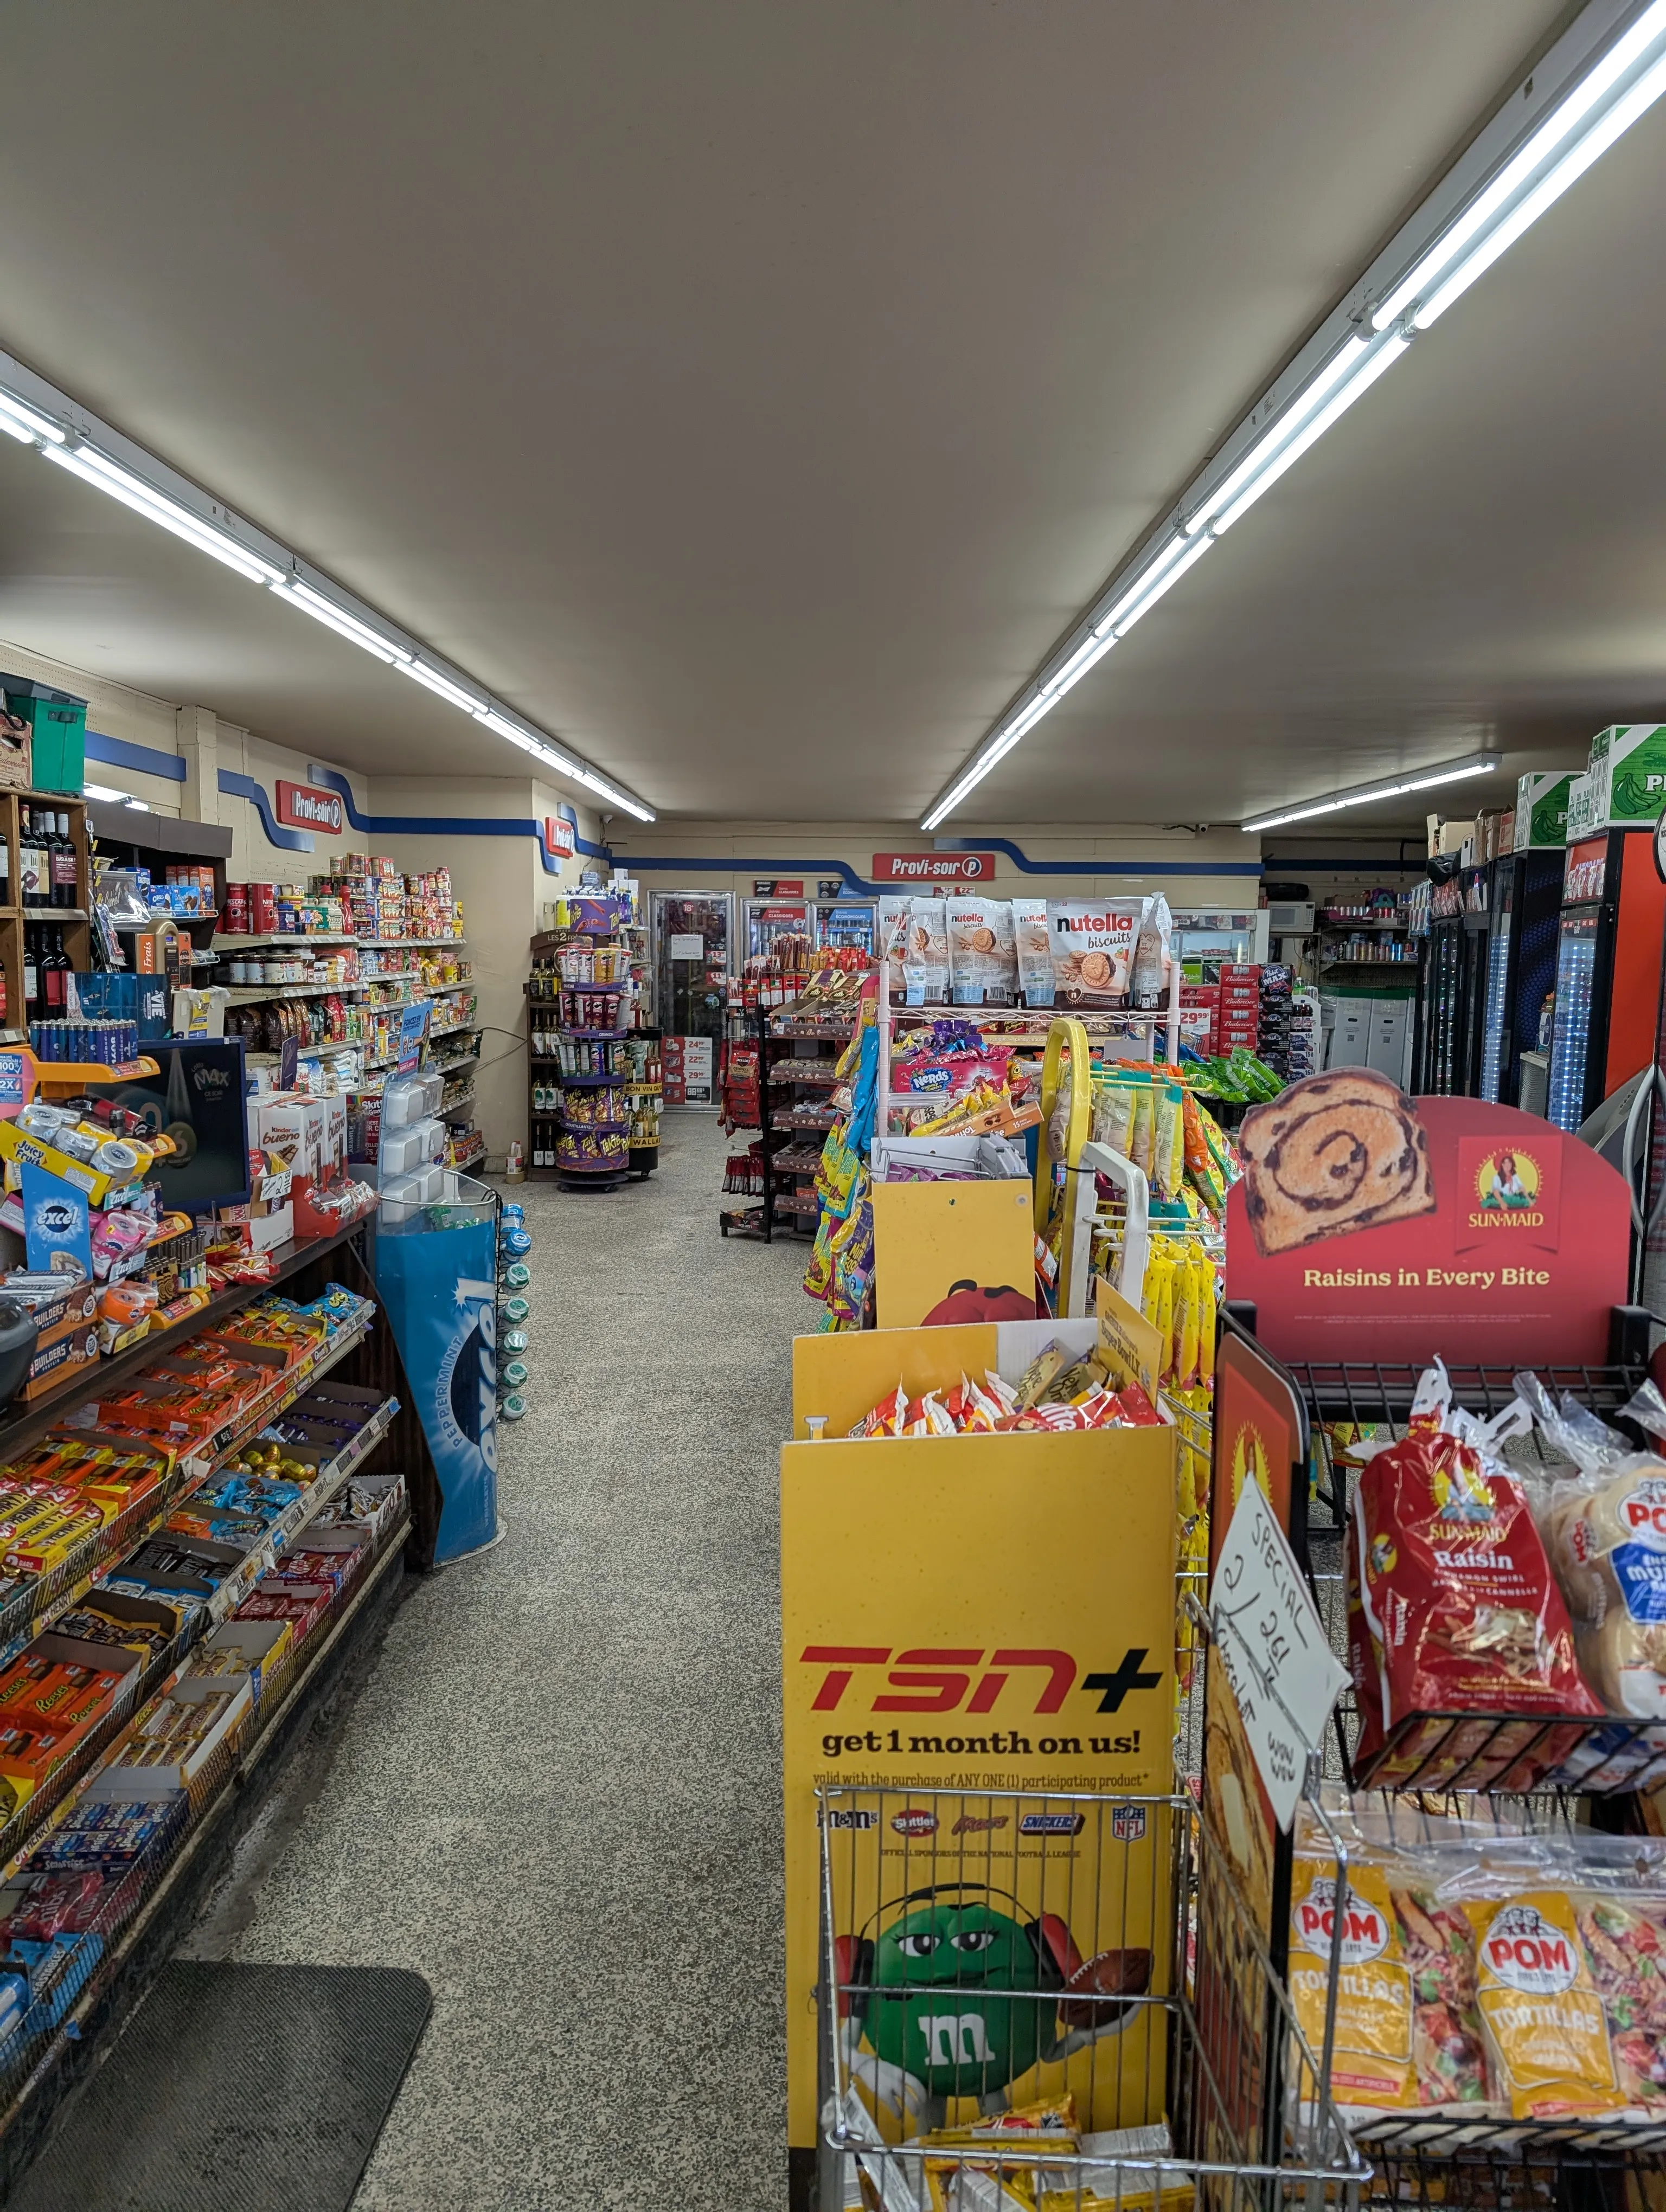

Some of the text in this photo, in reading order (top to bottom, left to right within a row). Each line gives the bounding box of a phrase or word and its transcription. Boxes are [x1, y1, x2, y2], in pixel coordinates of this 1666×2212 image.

[296, 791, 331, 823] Provi-soir
[892, 858, 960, 874] Provi-soir
[951, 914, 983, 923] nutella
[1057, 913, 1132, 933] nutella
[560, 933, 567, 941] 2
[1088, 932, 1133, 949] biscuits
[143, 941, 151, 967] Frais
[1263, 972, 1288, 987] MAX
[194, 1069, 230, 1090] MAX
[262, 1132, 300, 1145] bueno
[15, 1149, 42, 1166] Fruit
[17, 1140, 45, 1159] Juicy
[36, 1206, 79, 1226] excel
[1304, 1268, 1550, 1290] Raisins in Every Bite
[34, 1301, 65, 1326] BUILDERS
[34, 1343, 66, 1371] BUILDERS
[435, 1335, 462, 1449] PEPPERMINT
[1433, 1549, 1514, 1570] Raisin
[36, 1684, 69, 1714] Reese's
[822, 1729, 1140, 1758] get 1 month on us!
[813, 1771, 840, 1785] valid
[842, 1772, 868, 1785] with
[871, 1772, 889, 1785] the
[892, 1772, 942, 1789] purchase
[944, 1773, 955, 1786] of
[957, 1773, 981, 1787] ANY
[982, 1774, 1005, 1787] ONE
[1007, 1774, 1020, 1789] (1)
[1022, 1773, 1097, 1791] participating
[1115, 1820, 1143, 1837] NFL
[1301, 1907, 1381, 1944] POM
[1488, 1939, 1571, 1972] POM
[1489, 2007, 1599, 2035] TORTILLAS
[918, 2013, 996, 2066] m
